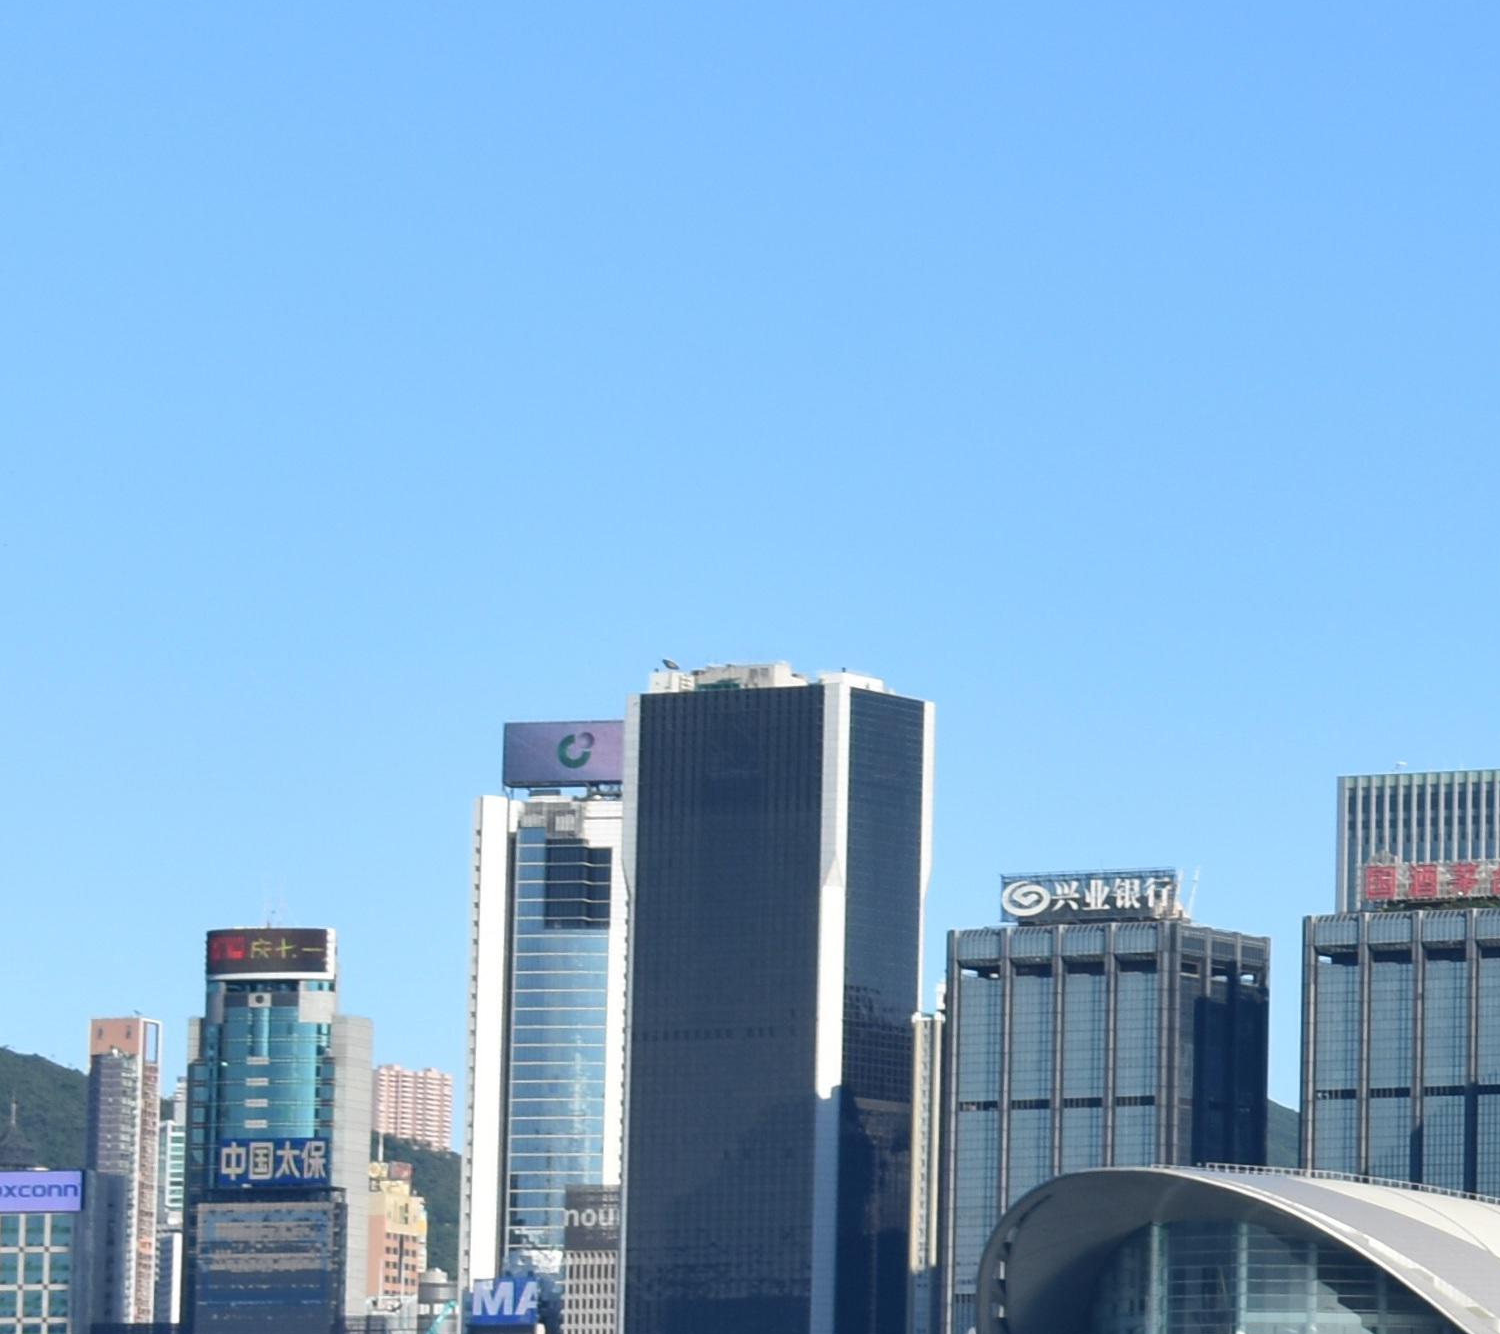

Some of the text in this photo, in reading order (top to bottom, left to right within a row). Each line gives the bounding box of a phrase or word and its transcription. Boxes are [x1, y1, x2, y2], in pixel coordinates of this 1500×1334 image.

[1051, 877, 1172, 911] 兴业银行
[220, 1140, 326, 1181] 中国太保
[0, 1184, 79, 1198] xconn
